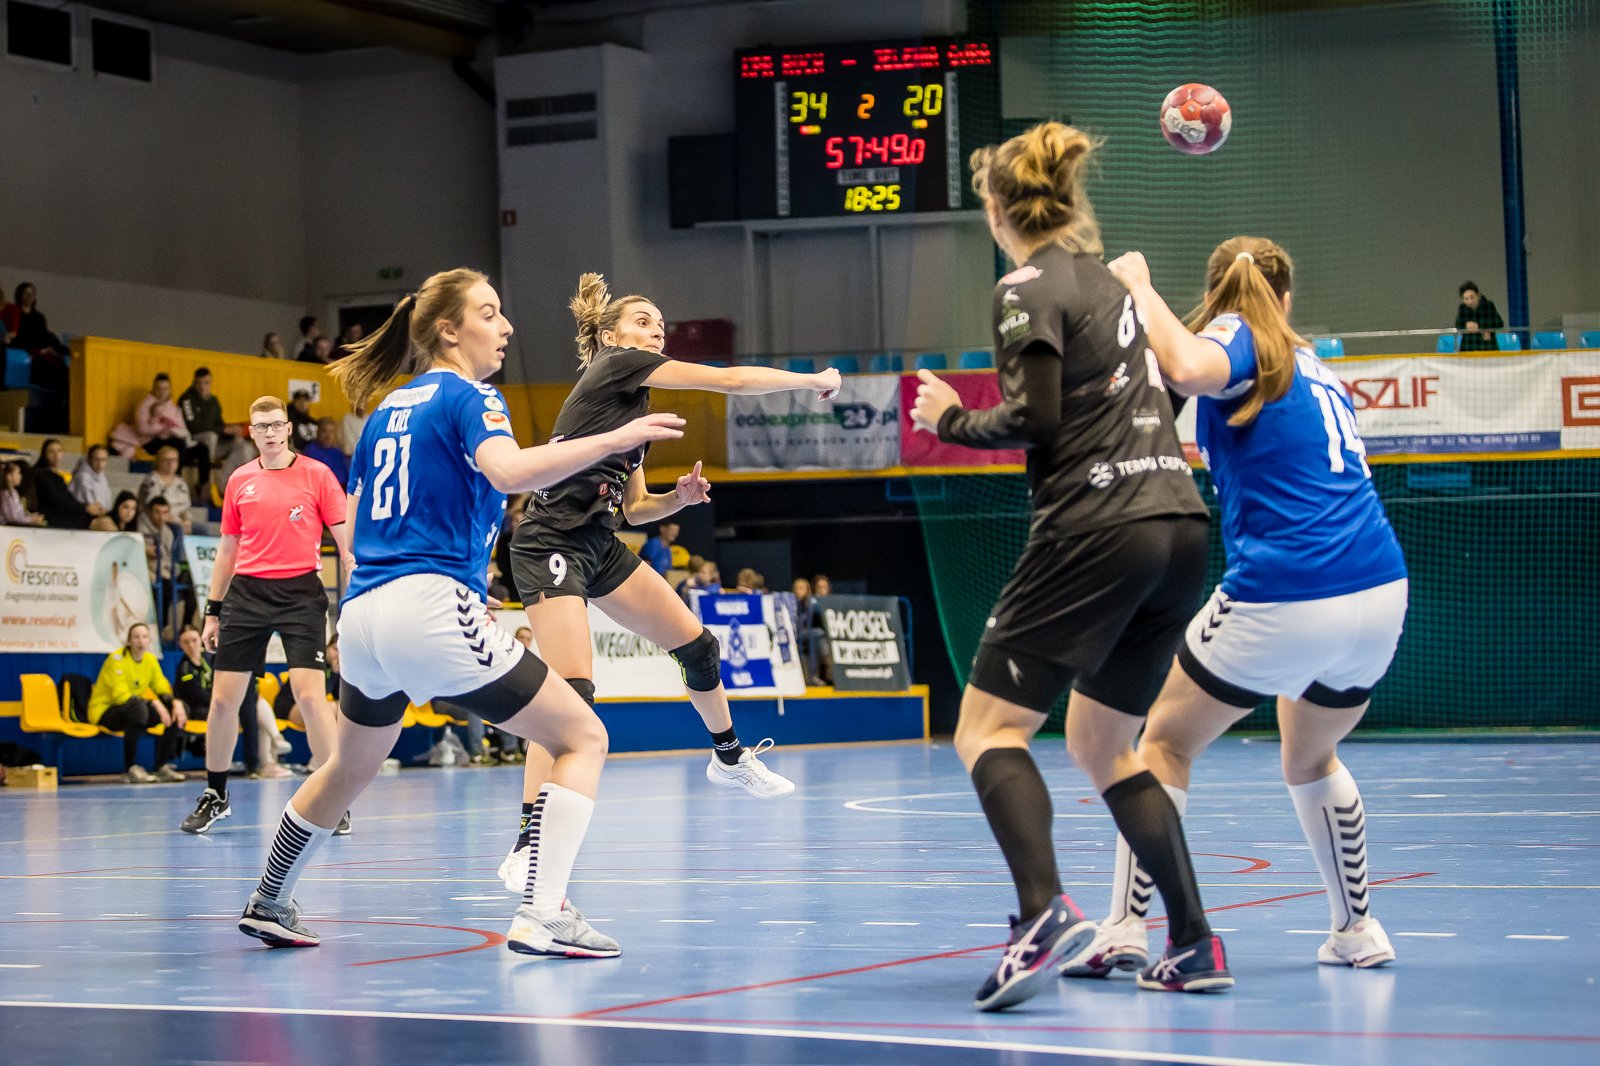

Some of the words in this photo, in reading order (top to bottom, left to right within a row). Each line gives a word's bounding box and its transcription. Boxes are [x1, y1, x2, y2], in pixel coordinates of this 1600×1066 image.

[789, 91, 828, 123] 34
[857, 93, 875, 119] 2
[903, 83, 943, 116] 20
[845, 185, 901, 211] 18:25
[371, 433, 412, 521] 21
[20, 568, 79, 587] resonica
[549, 553, 567, 586] 9
